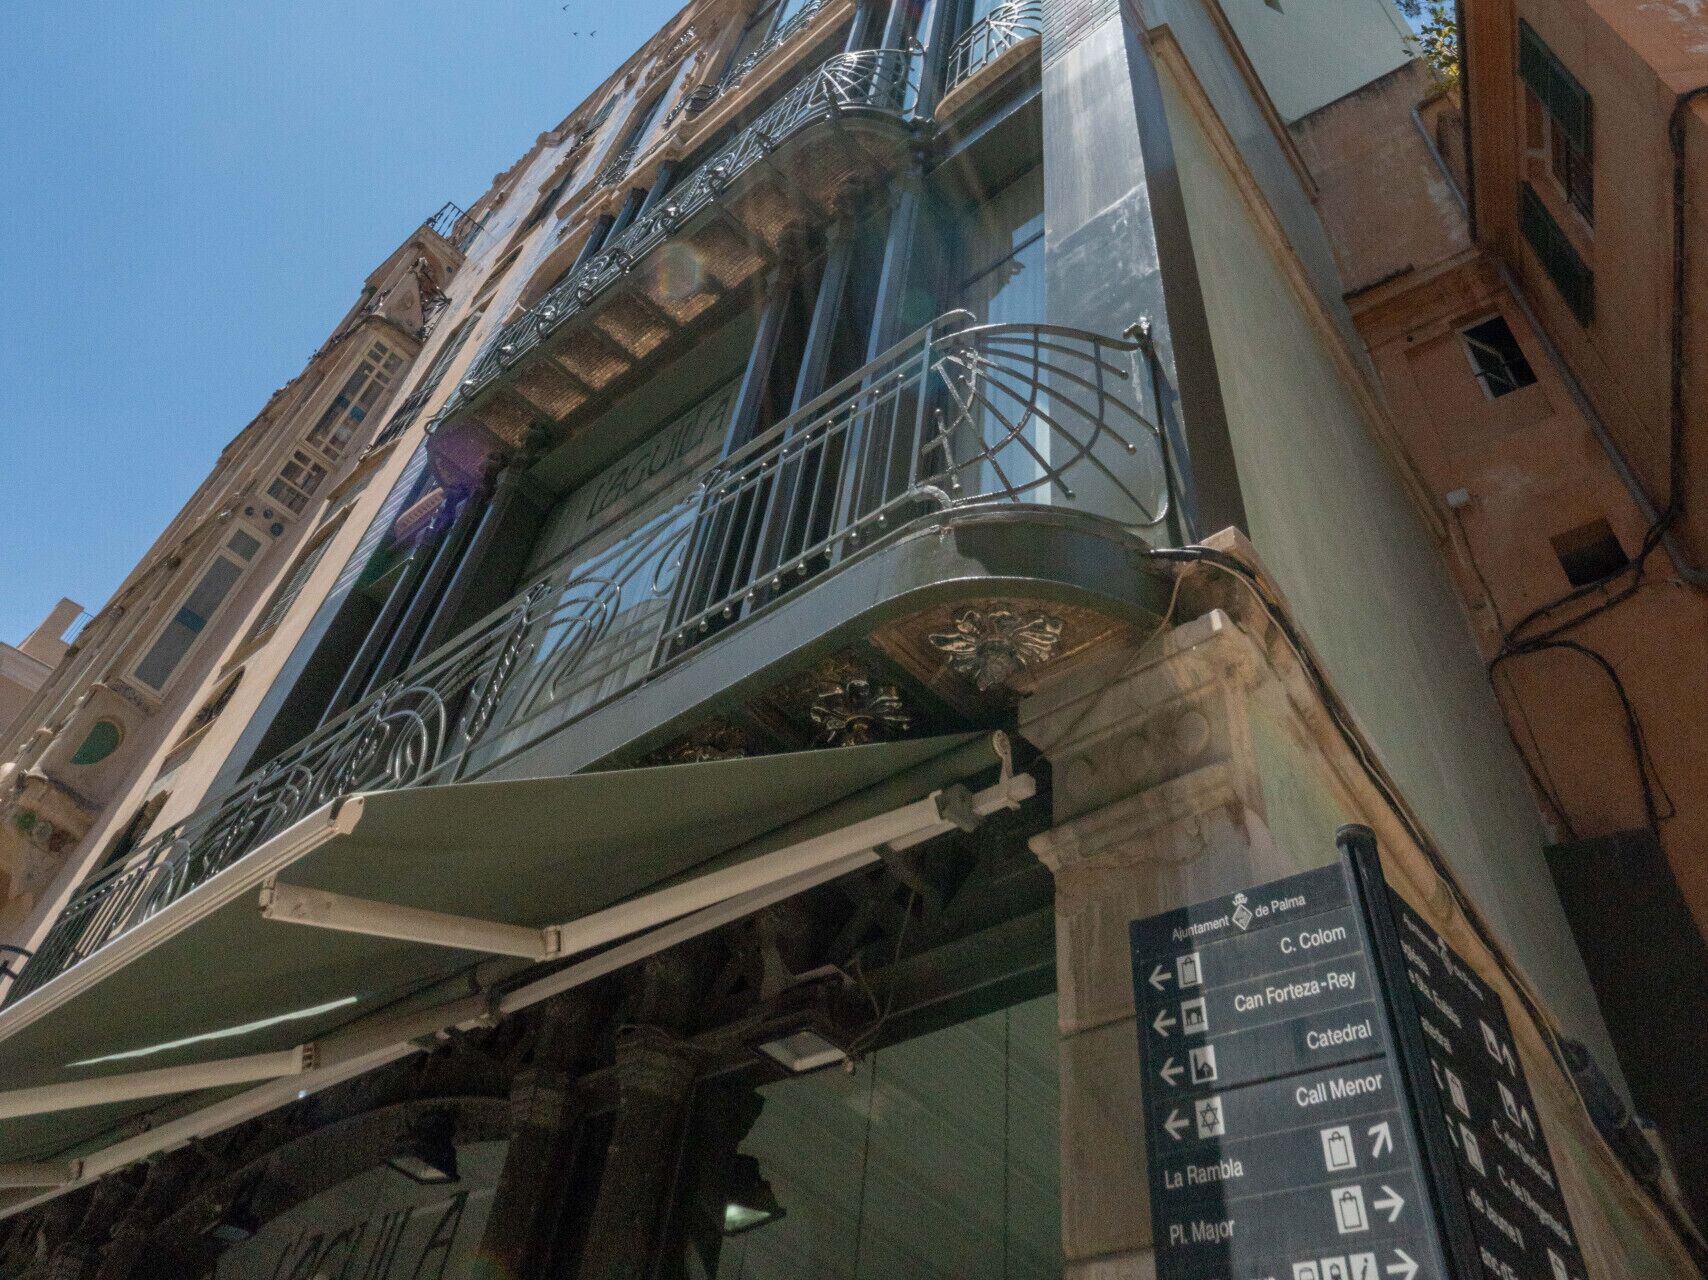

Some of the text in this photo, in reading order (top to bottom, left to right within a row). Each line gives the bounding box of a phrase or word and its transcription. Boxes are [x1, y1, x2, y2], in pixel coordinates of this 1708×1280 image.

[1255, 893, 1305, 918] de Palma
[1172, 914, 1230, 941] Ajuntament
[1281, 925, 1347, 955] C. Colom
[1234, 971, 1357, 1013] Can Forteza-Rey
[1306, 1021, 1372, 1051] Catedral
[1296, 1074, 1383, 1107] Call Menor
[1165, 1159, 1244, 1189] La Rambla
[1169, 1216, 1235, 1246] Pl. Major
